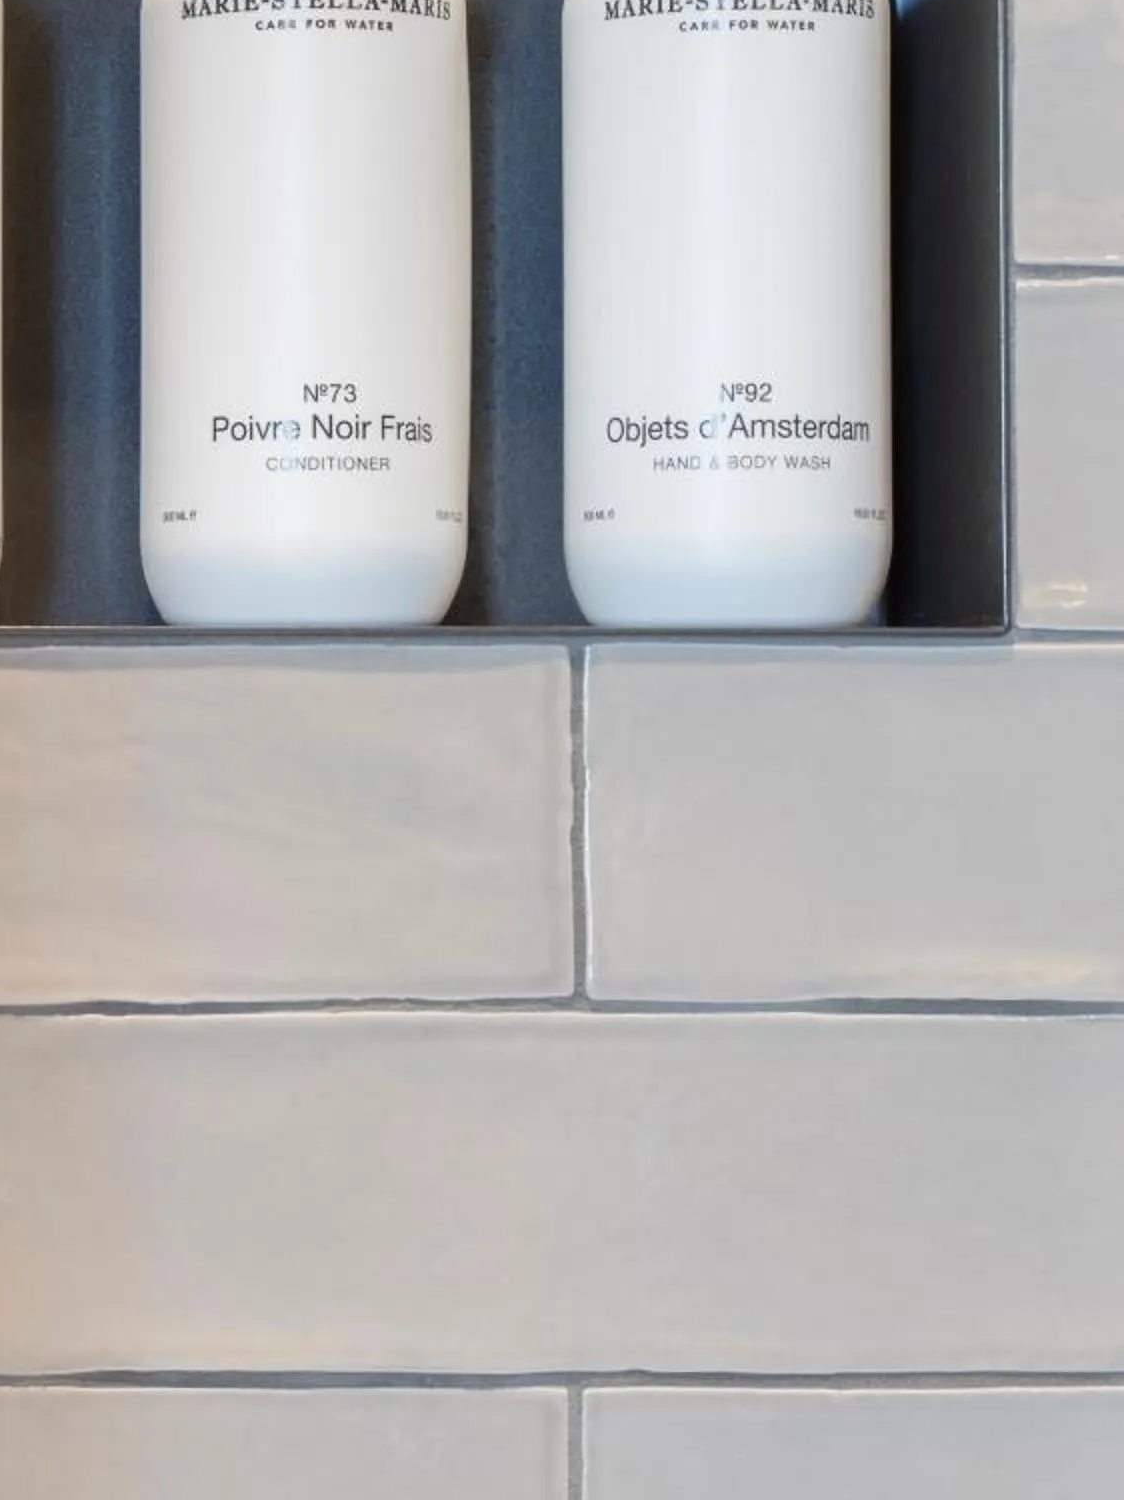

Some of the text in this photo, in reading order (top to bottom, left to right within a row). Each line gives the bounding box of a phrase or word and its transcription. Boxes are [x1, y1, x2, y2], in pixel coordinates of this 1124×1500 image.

[255, 19, 394, 32] CARE FOR WATER
[679, 19, 815, 32] CARE FOR WATER
[212, 414, 433, 443] Poivre Noir Frais
[606, 416, 689, 448] Objets
[265, 456, 390, 472] CONDITIONER
[653, 456, 701, 471] HAND
[728, 455, 777, 470] BODY
[784, 455, 831, 470] WASH
